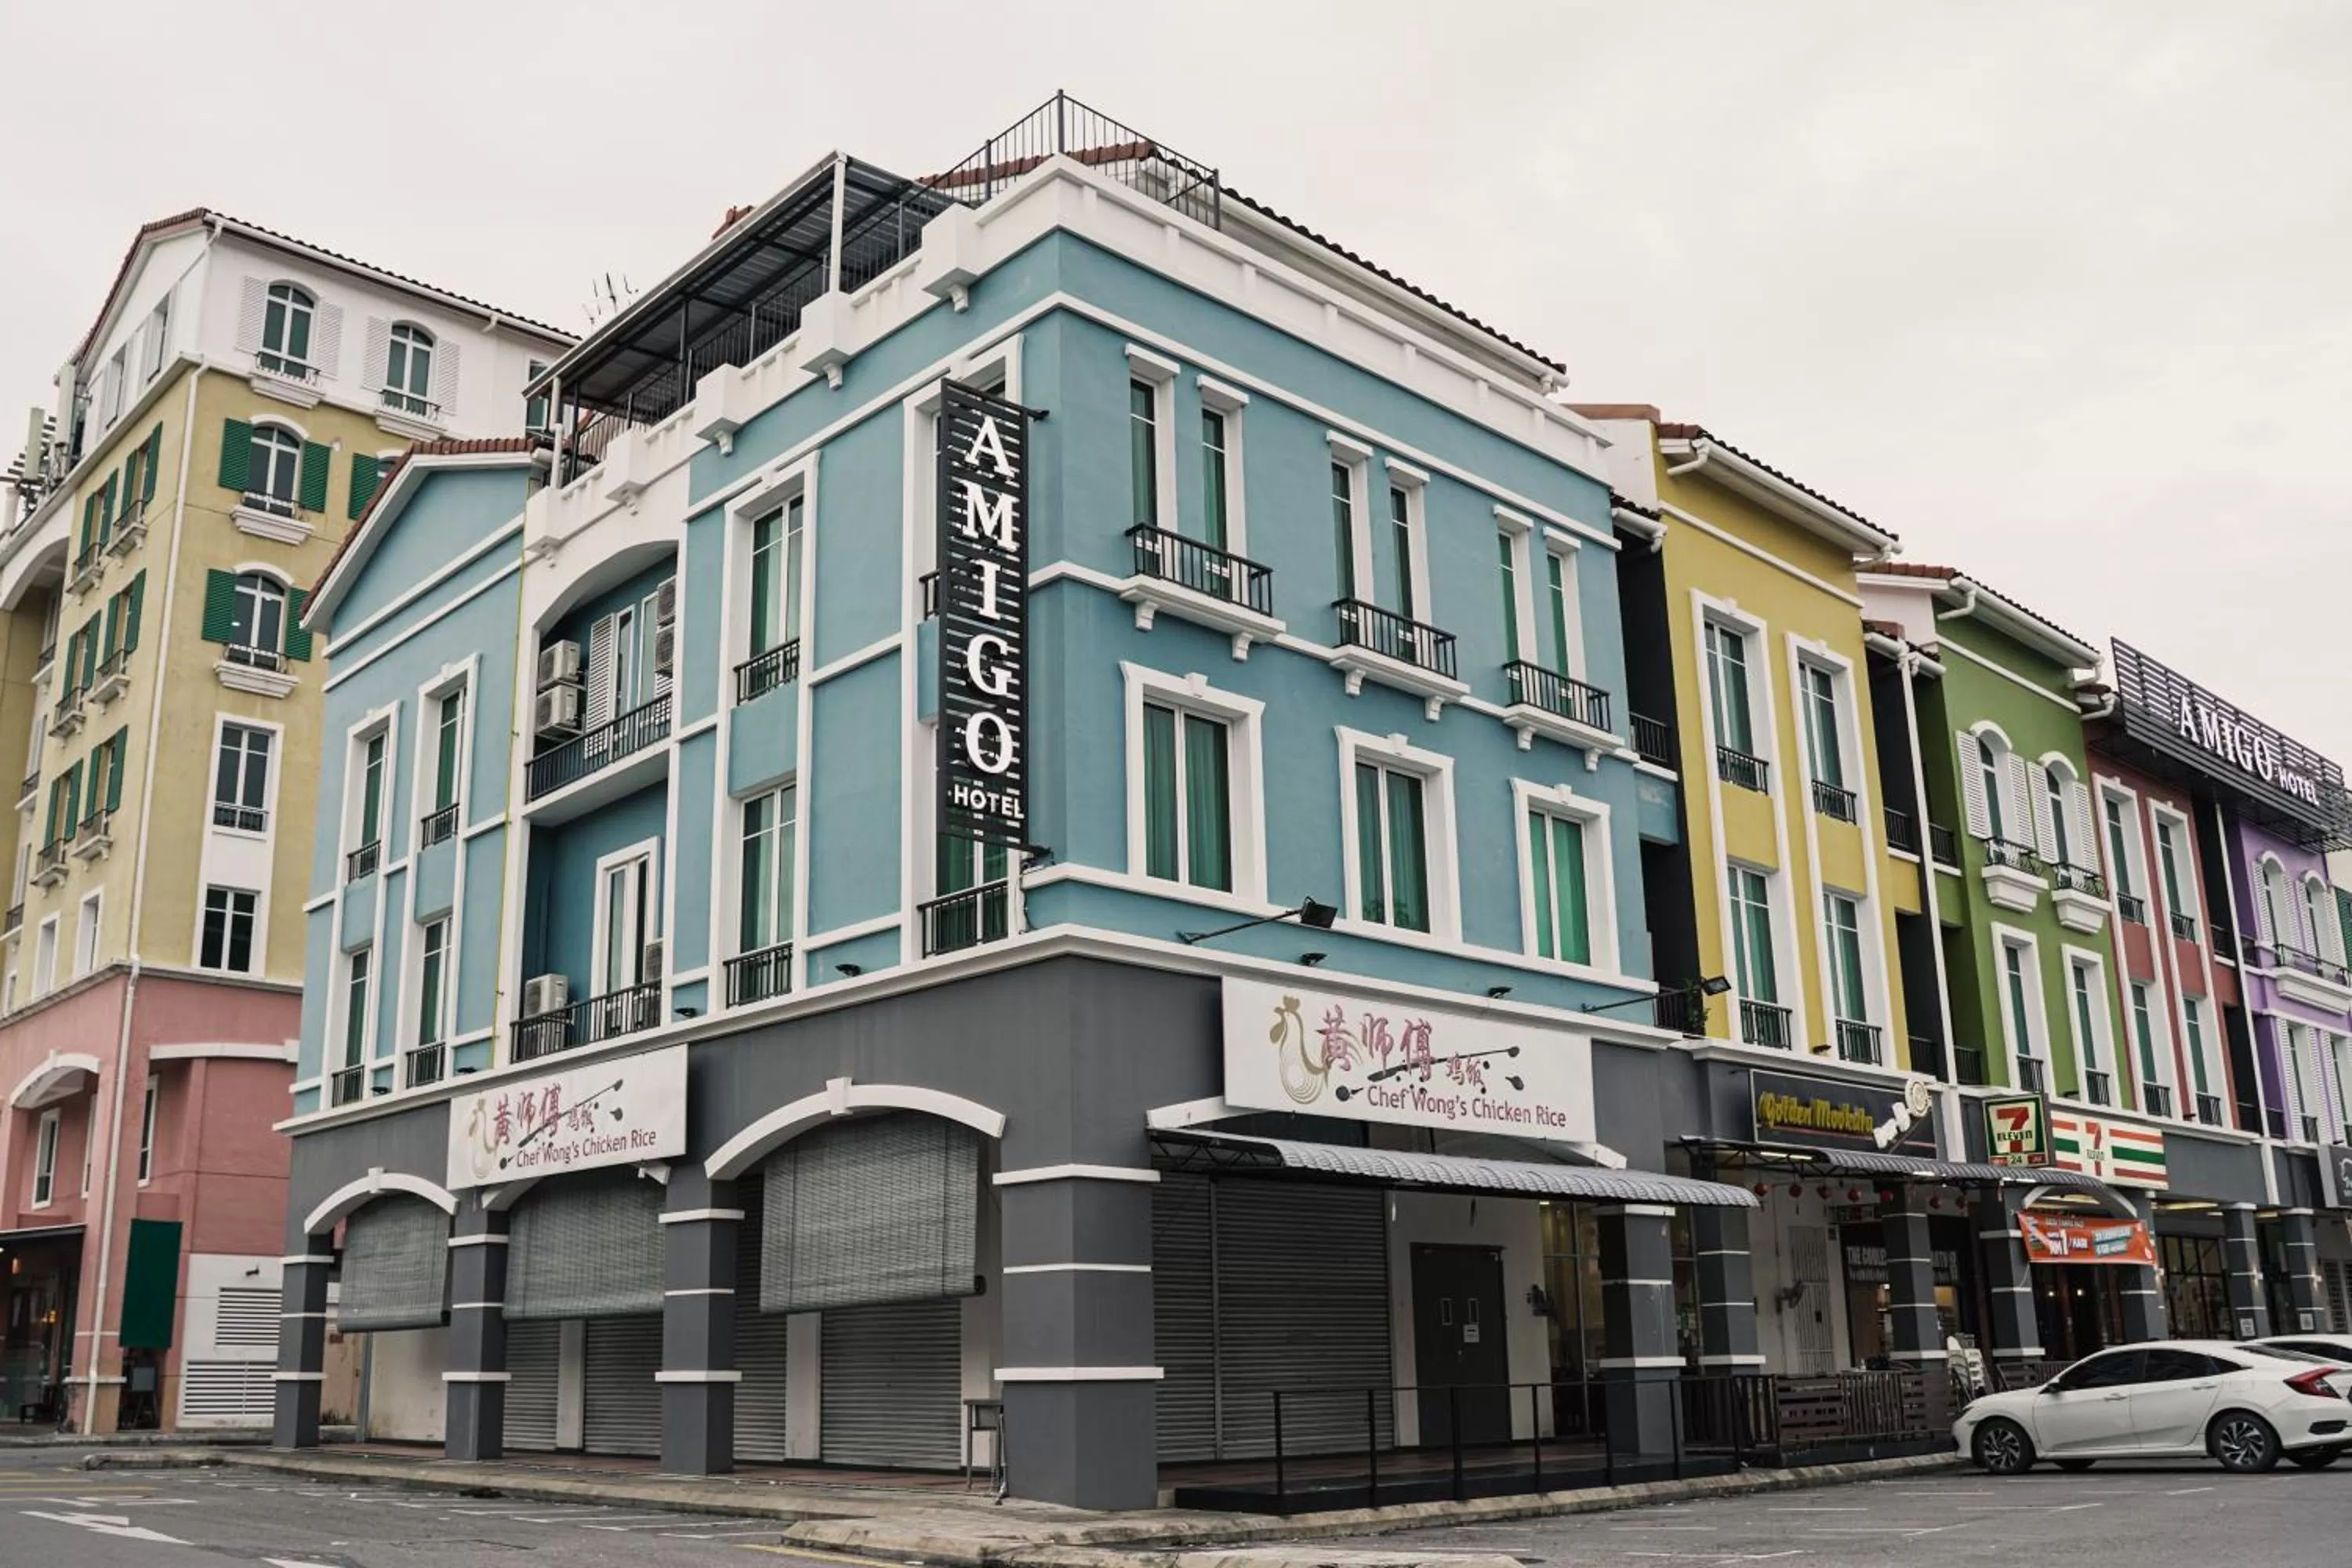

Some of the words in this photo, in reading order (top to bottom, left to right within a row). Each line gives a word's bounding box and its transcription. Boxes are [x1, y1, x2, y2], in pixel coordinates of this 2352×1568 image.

[961, 416, 1017, 775] AMIGO
[2180, 694, 2273, 782] AMIGO
[954, 783, 1025, 819] HOTEL
[2278, 766, 2320, 806] HOTEL
[1367, 1085, 1410, 1110] Chef
[1412, 1088, 1468, 1120] Wong's
[1472, 1098, 1531, 1124] Chicken
[1536, 1105, 1567, 1127] Rice
[516, 1146, 540, 1167] Chef
[543, 1142, 579, 1164] Wong's
[583, 1134, 627, 1156] Chicken
[631, 1128, 656, 1149] Rice
[2010, 1155, 2023, 1164] 24
[2085, 1121, 2102, 1176] 7
